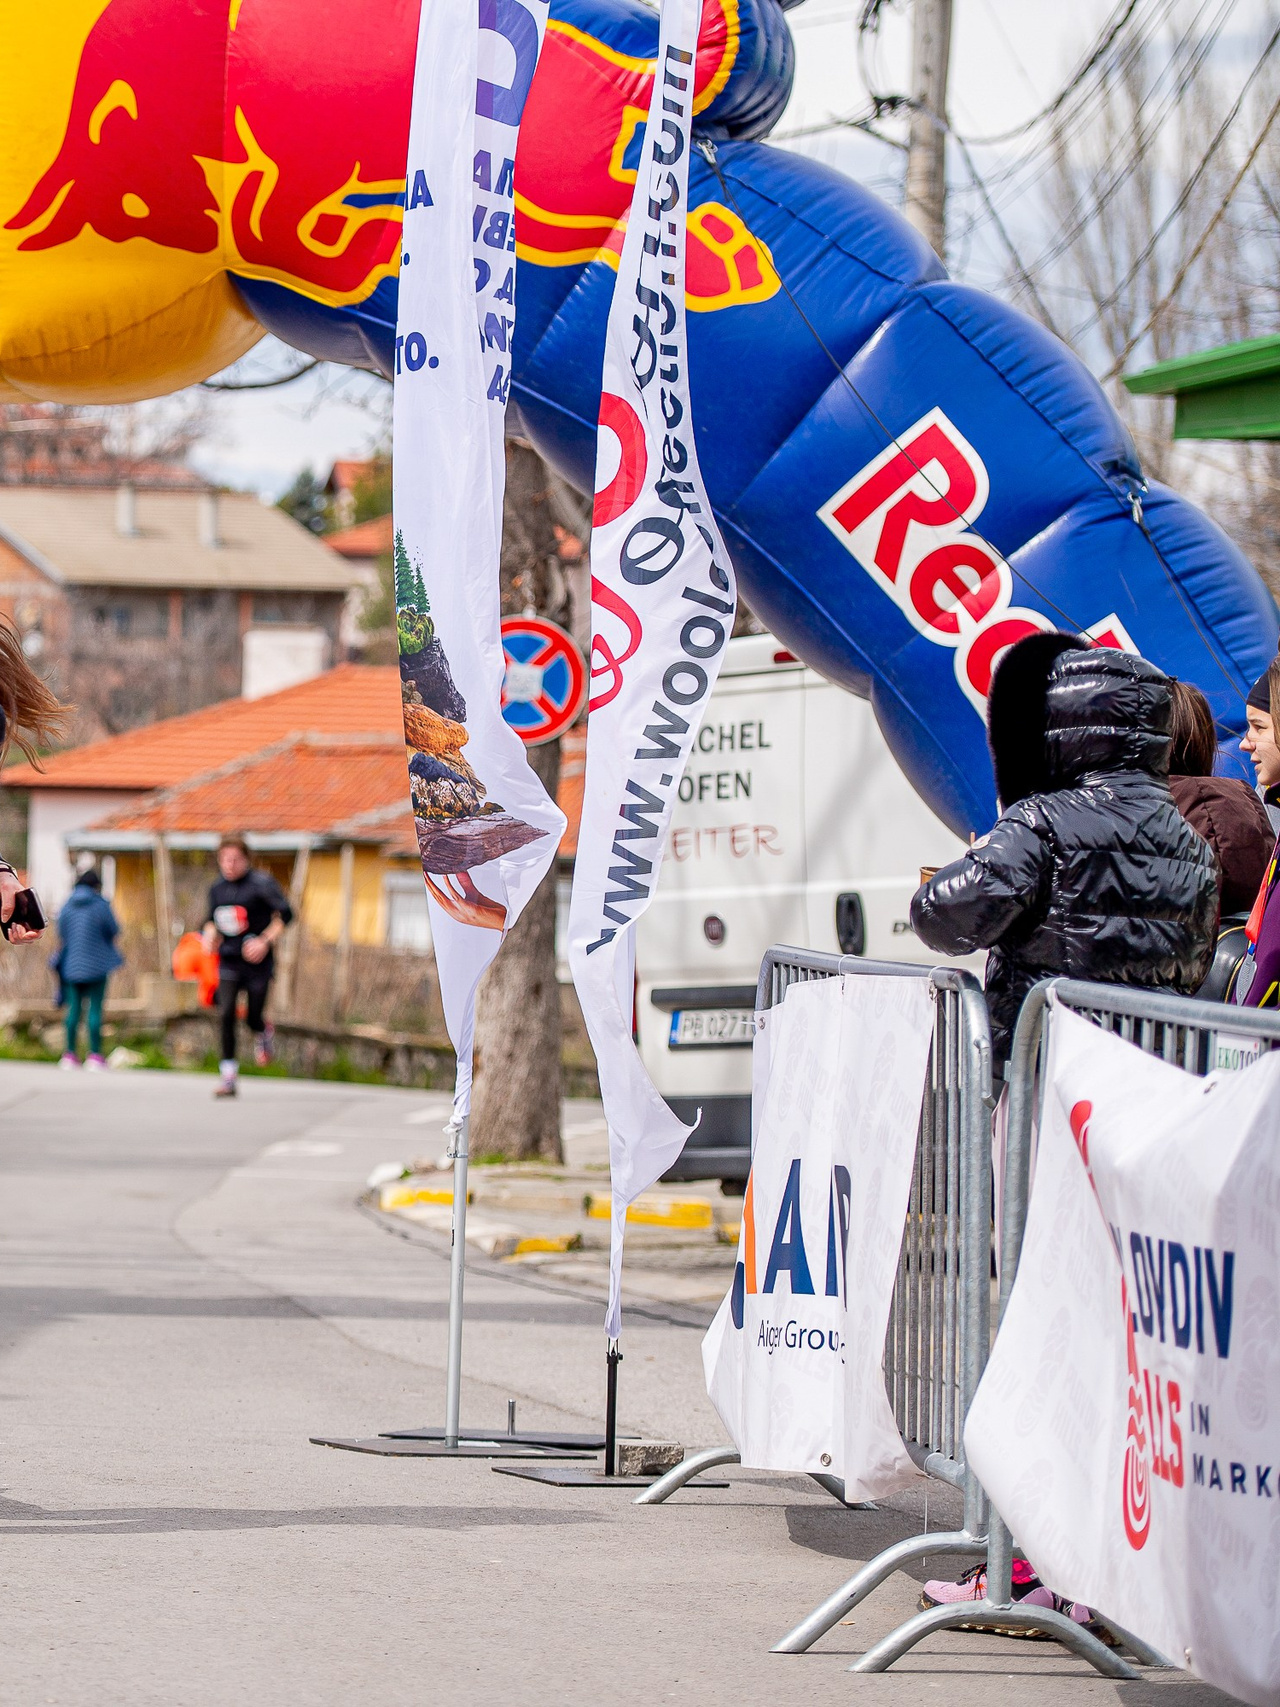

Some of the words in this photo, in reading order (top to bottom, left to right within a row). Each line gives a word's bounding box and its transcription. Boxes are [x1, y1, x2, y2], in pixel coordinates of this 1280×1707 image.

[691, 722, 771, 754] CHEL
[666, 823, 784, 862] EITER
[757, 1319, 782, 1355] Aiger
[1190, 1401, 1210, 1436] IN
[1193, 1452, 1280, 1498] MARK
